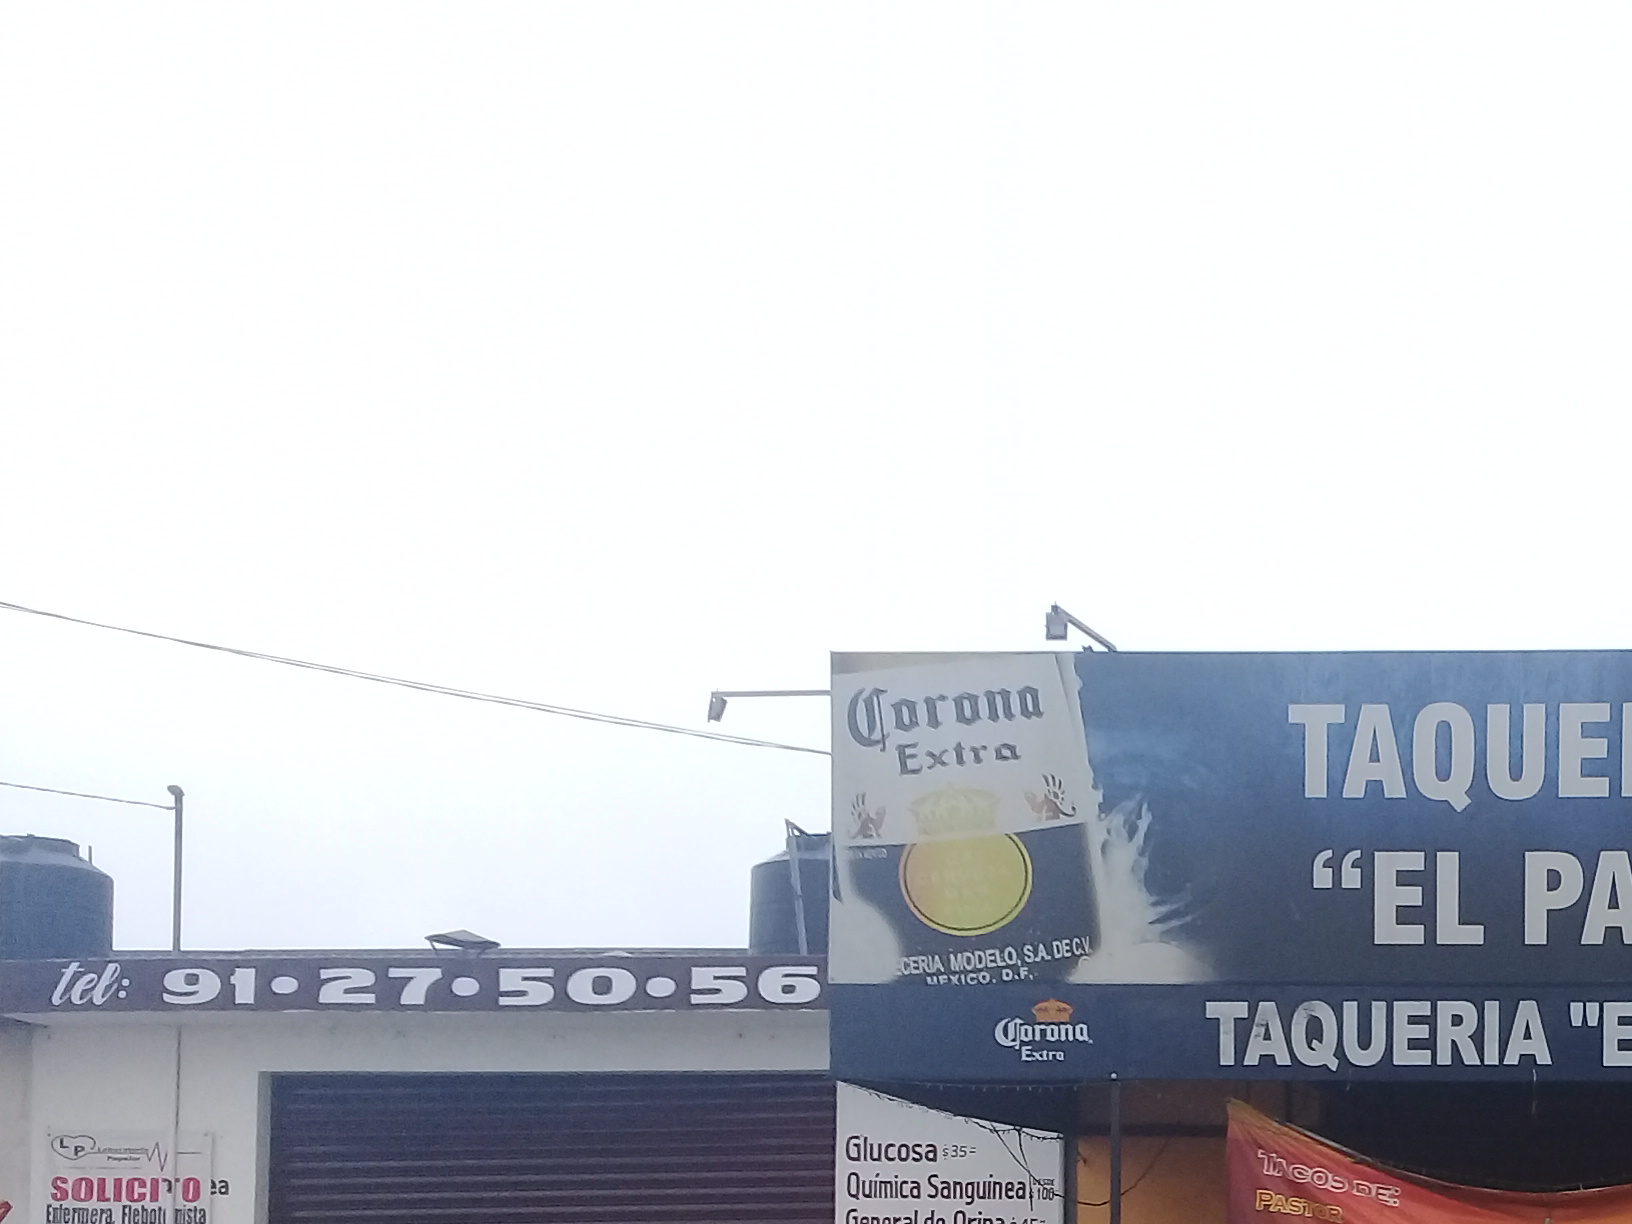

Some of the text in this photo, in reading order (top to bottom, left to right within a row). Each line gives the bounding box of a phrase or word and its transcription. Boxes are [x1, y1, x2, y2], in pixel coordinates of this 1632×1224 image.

[848, 686, 1045, 752] Corona
[899, 743, 1021, 776] Extra
[51, 962, 130, 1006] tel:
[994, 1017, 1090, 1048] Corona
[1206, 1001, 1552, 1071] TAQUERIA
[1020, 1046, 1065, 1061] Extra
[845, 1135, 938, 1162] Glucosa
[50, 1176, 202, 1202] SOLICIO
[846, 1171, 921, 1200] Química
[1257, 1149, 1402, 1207] TACOS DE:
